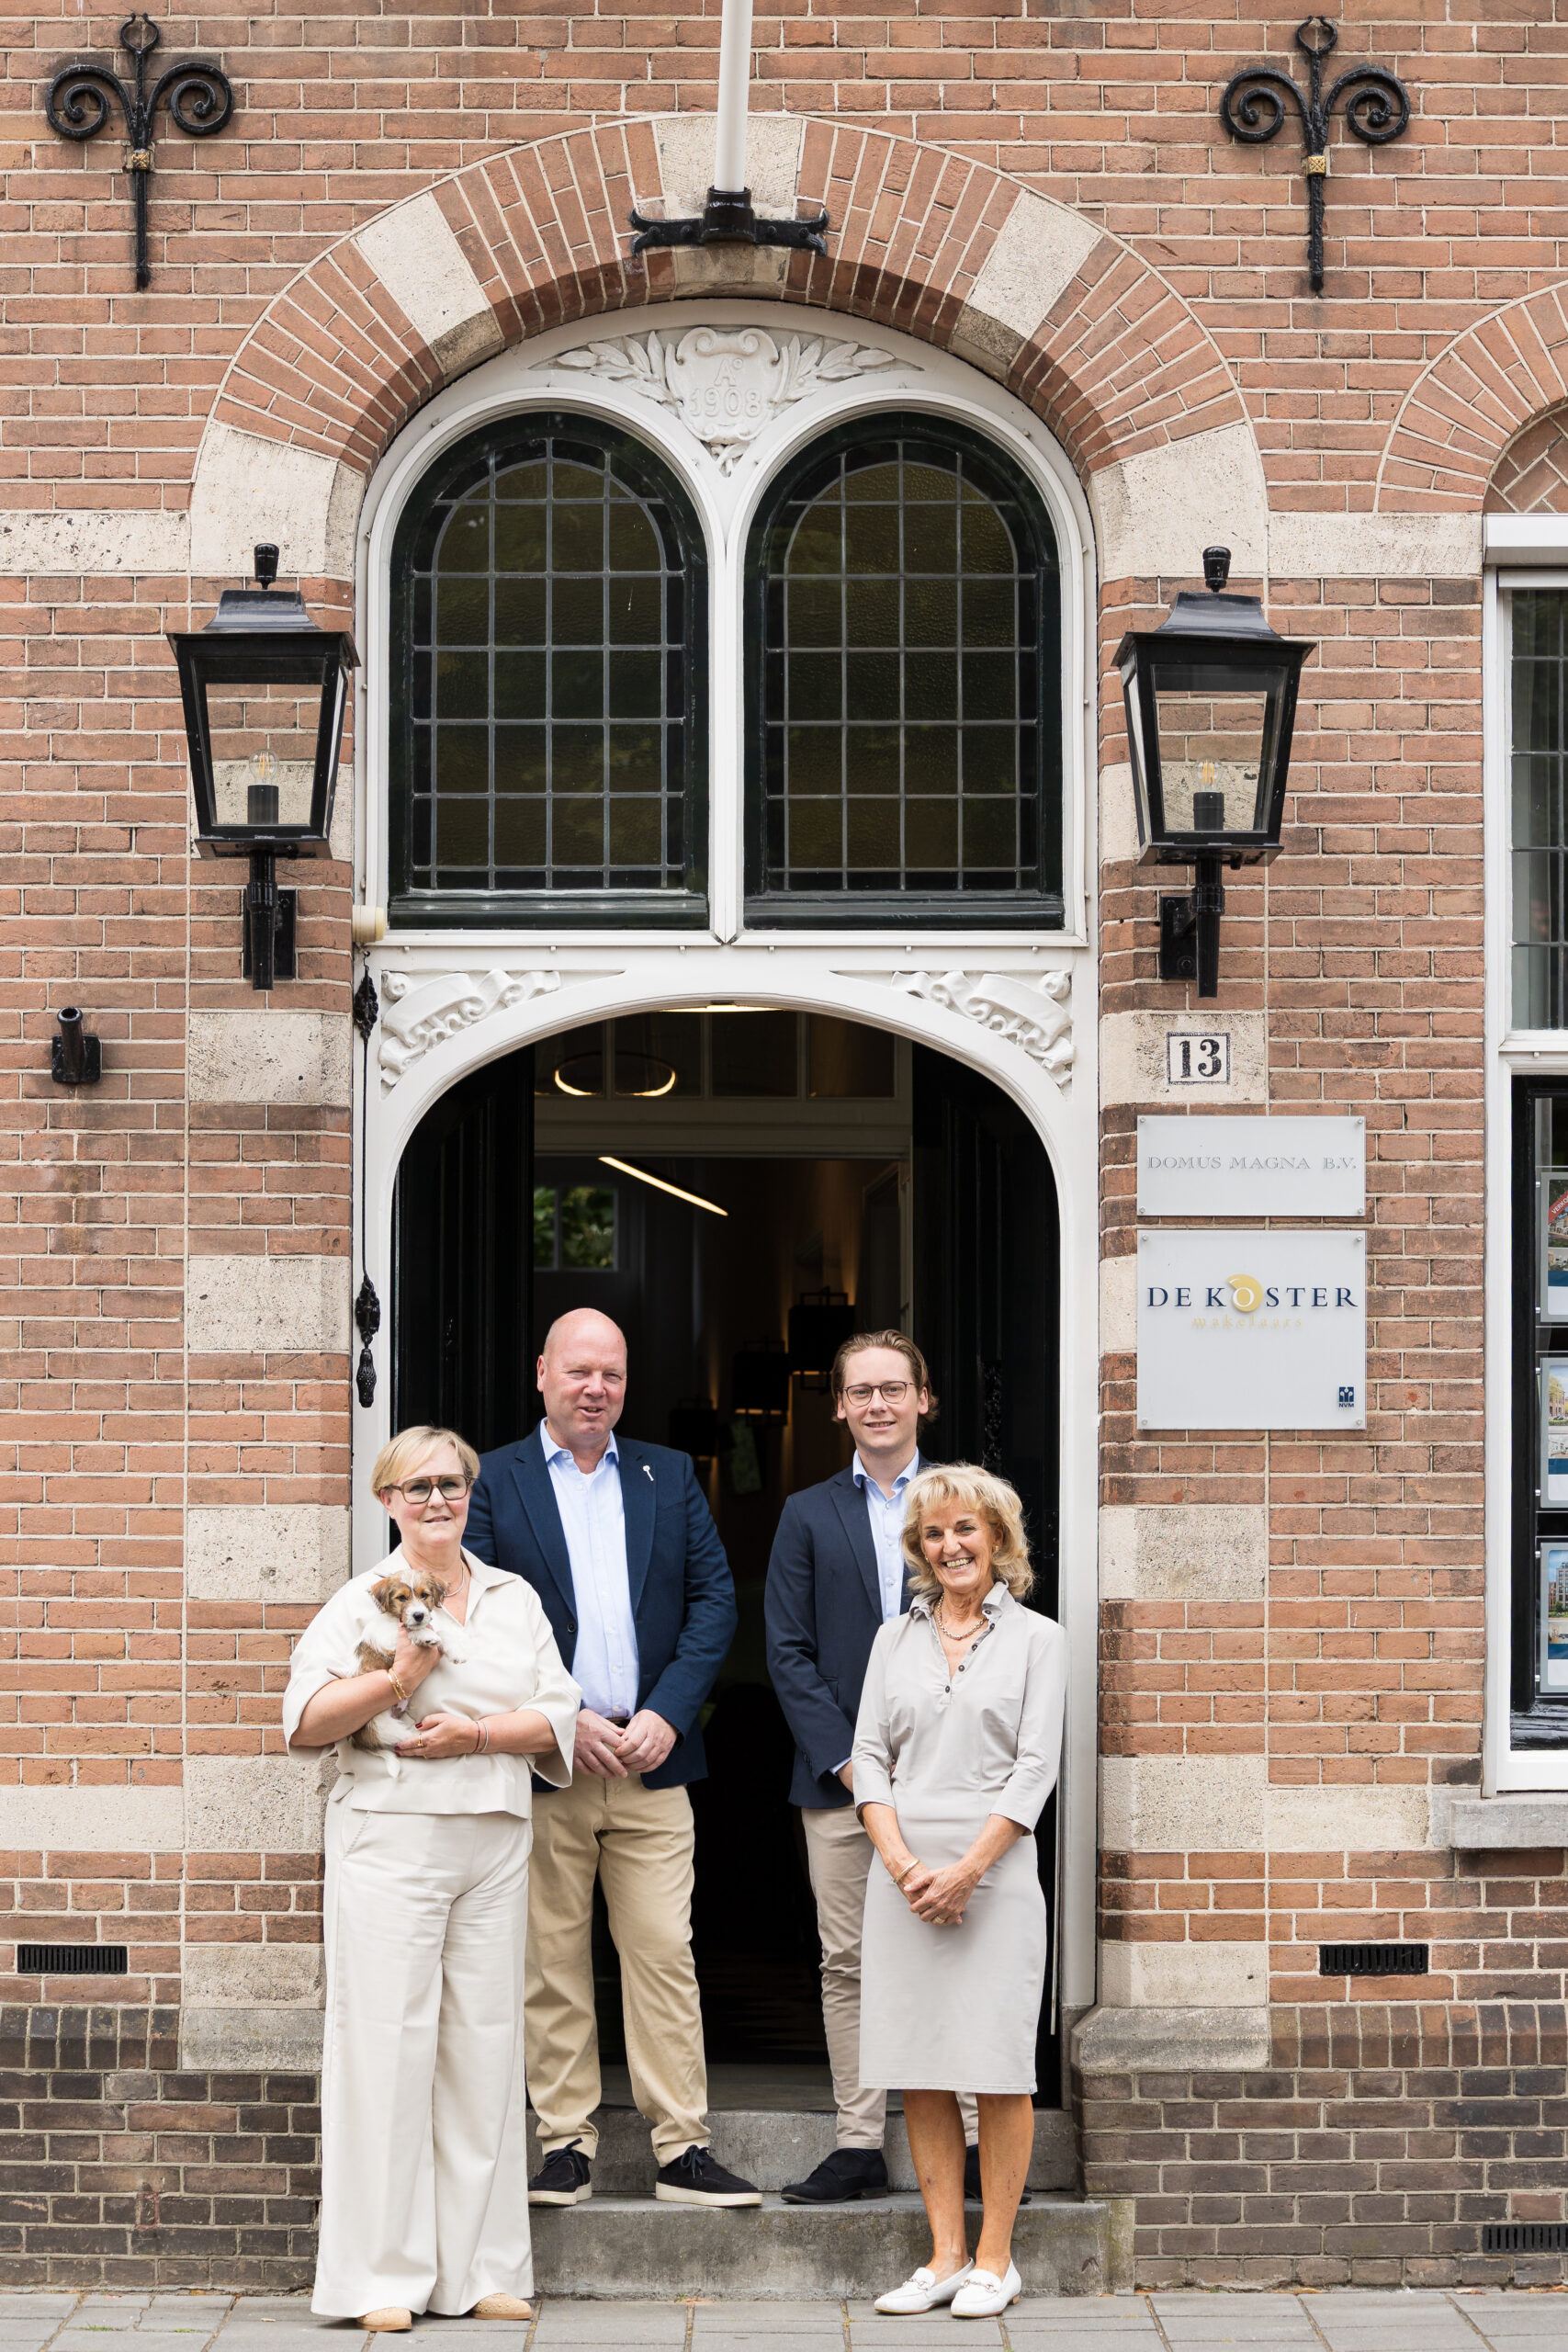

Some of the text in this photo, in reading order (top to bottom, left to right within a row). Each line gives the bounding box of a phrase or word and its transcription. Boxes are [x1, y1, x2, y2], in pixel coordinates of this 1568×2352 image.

[689, 387, 762, 418] 1908
[1179, 1038, 1222, 1079] 13
[1147, 1156, 1357, 1170] DOMUS MAGNA B.V.
[1551, 1195, 1568, 1214] VERKO
[1146, 1286, 1359, 1307] DE KOSTER
[1193, 1314, 1303, 1328] makelaars
